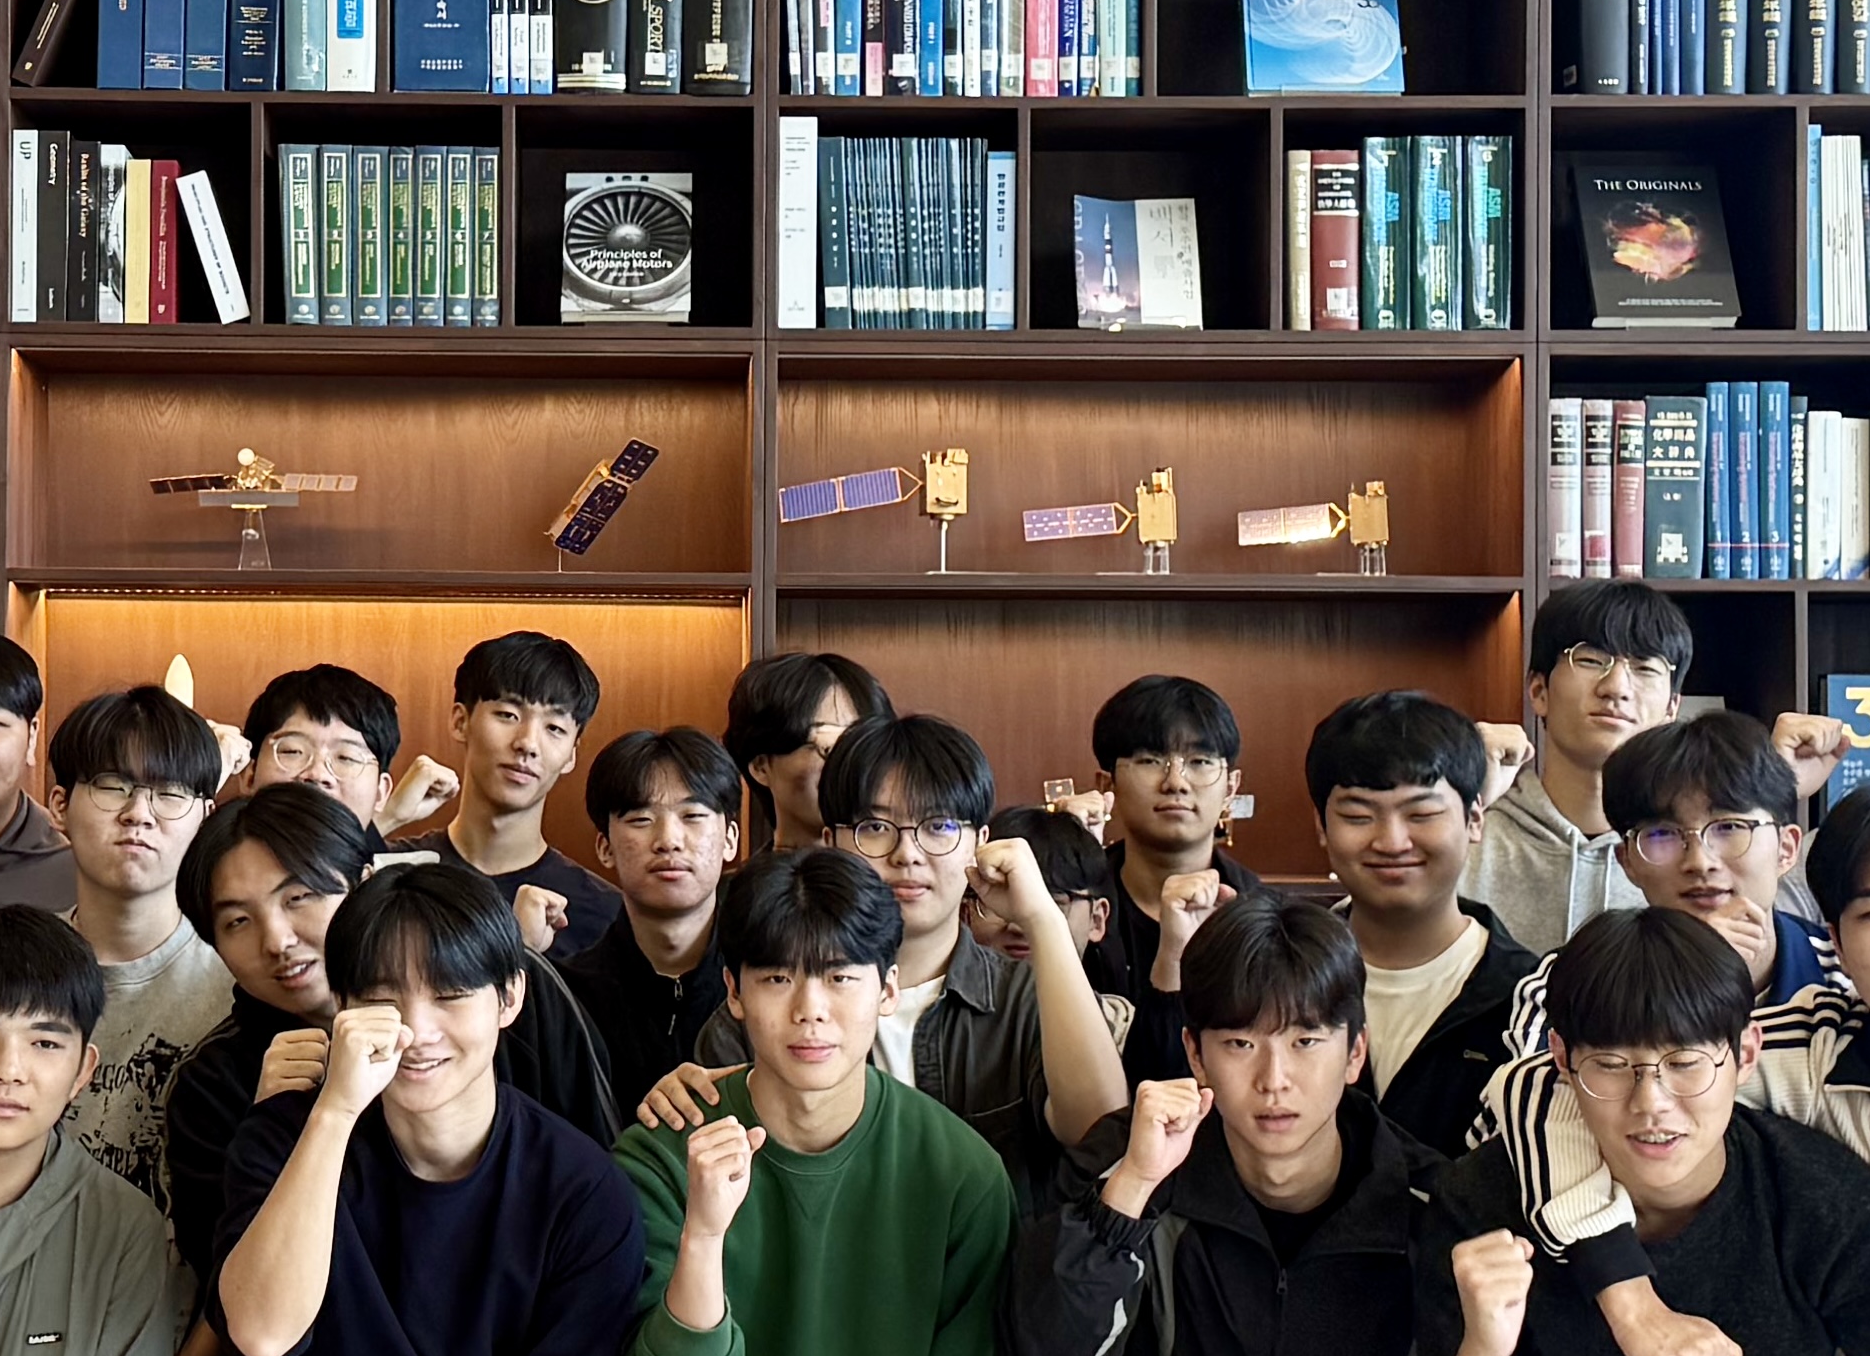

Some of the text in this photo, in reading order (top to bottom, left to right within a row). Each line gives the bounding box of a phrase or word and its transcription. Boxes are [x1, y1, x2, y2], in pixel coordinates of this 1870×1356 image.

[19, 141, 32, 160] UP
[1593, 179, 1703, 192] THE ORIGINALS
[589, 248, 663, 260] Principles of
[632, 258, 673, 268] Motors
